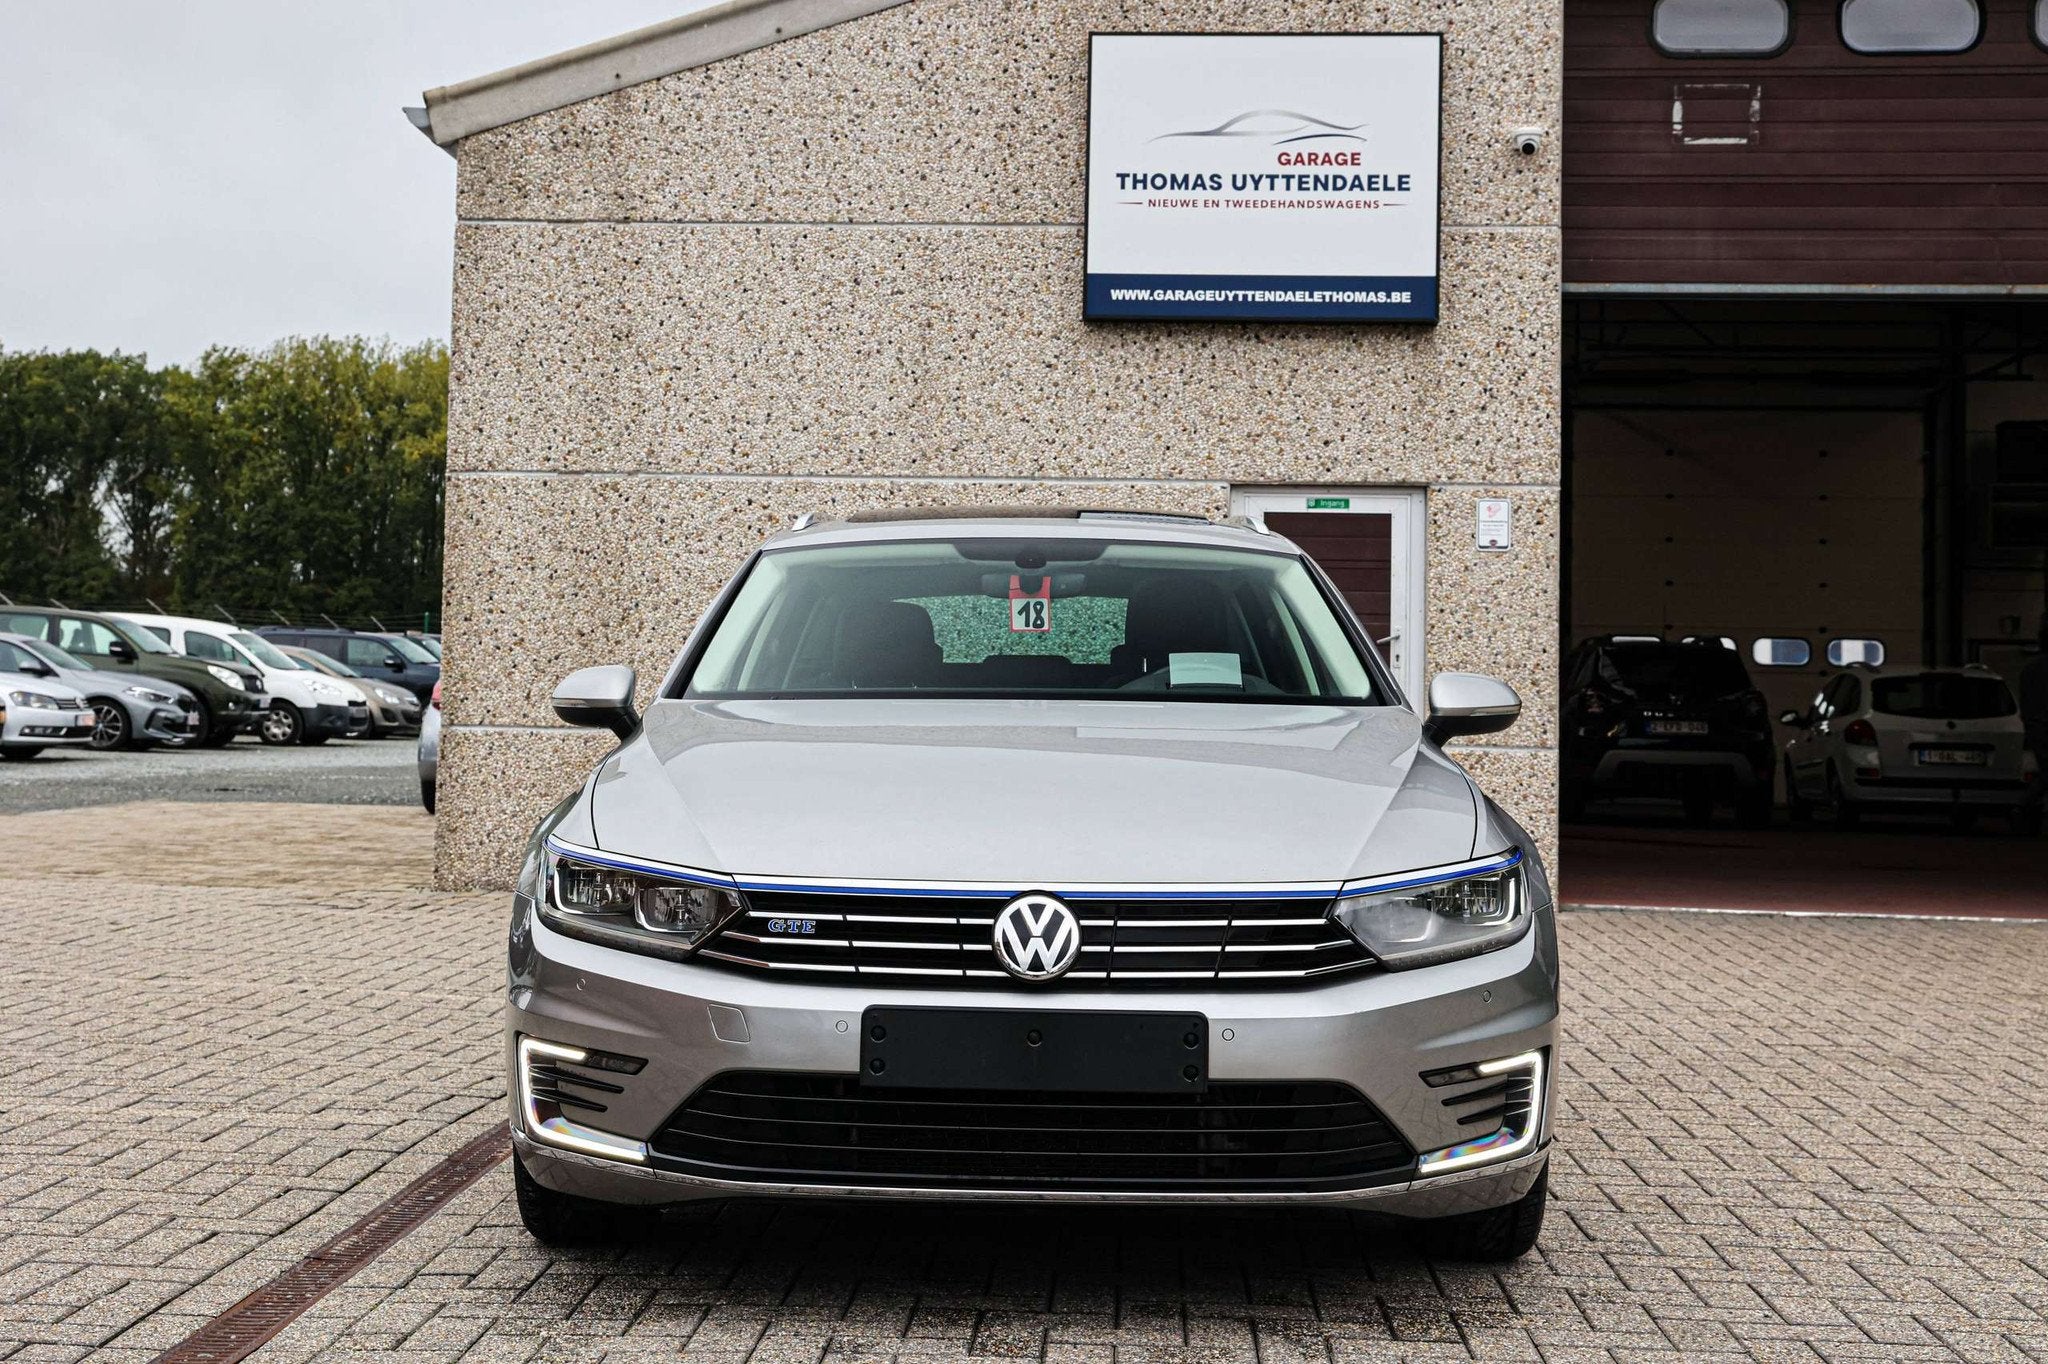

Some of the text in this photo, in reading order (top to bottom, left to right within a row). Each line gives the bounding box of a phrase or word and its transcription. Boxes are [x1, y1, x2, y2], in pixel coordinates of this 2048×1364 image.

[1277, 152, 1362, 166] GARAGE
[1116, 173, 1411, 192] THOMAS UYTTENDAELE
[1148, 198, 1380, 209] NIEUWE EN TWEEDEHANDSWAGENS
[1110, 288, 1412, 303] WWW.GARAGEUYTTENDAELETHOMAS.BE
[1320, 499, 1345, 508] Ingang
[1017, 600, 1045, 629] 18
[768, 918, 817, 934] GTE
[999, 899, 1073, 975] VW
